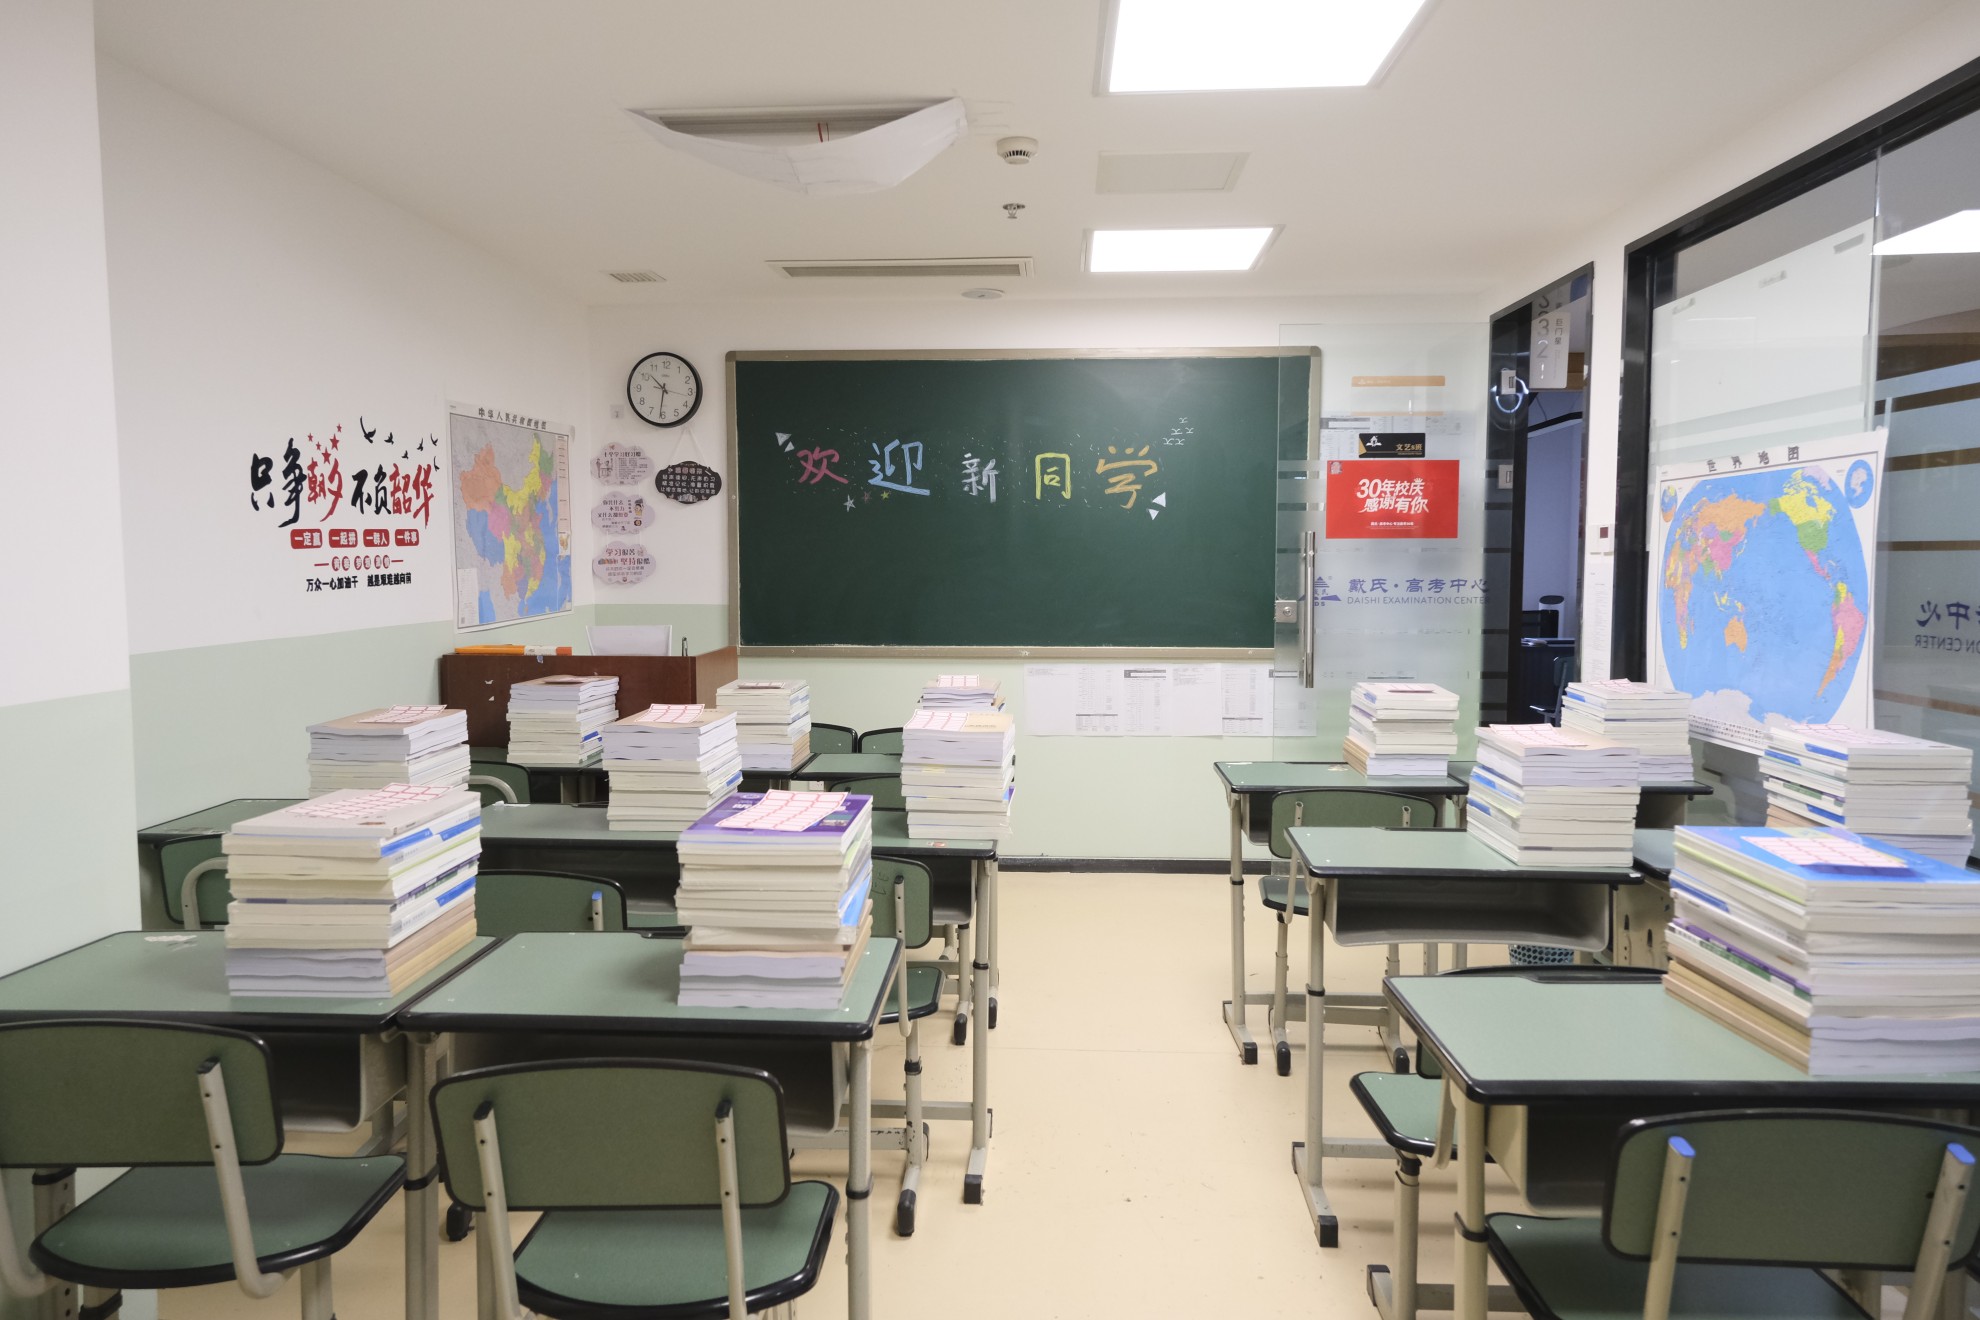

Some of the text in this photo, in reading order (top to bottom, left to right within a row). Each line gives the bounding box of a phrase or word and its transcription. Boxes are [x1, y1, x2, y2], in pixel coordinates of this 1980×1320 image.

[650, 364, 658, 372] 11
[662, 360, 671, 369] 12
[684, 376, 690, 384] 2
[636, 384, 642, 392] 9
[688, 388, 694, 396] 3
[640, 397, 645, 406] 8
[683, 400, 688, 408] 4
[649, 406, 654, 415] 7
[660, 411, 666, 419] 6
[674, 408, 680, 417] 5
[478, 407, 547, 430] 中华人民共和国地图
[1706, 446, 1800, 472] 世界地图
[797, 439, 1158, 509] 欢迎新同学
[250, 438, 434, 529] 只争朝夕 不负韶华
[1356, 478, 1426, 498] 30年校庆
[1358, 494, 1430, 514] 感谢有你
[294, 530, 418, 546] 一定赢 一起拼 一群人 一件事
[306, 572, 412, 592] 万众一心加油干 越是艰难越向前
[1348, 578, 1490, 594] 戴氏·高考中心
[1347, 596, 1380, 605] DAISHI
[1383, 596, 1452, 605] EXAMINATION
